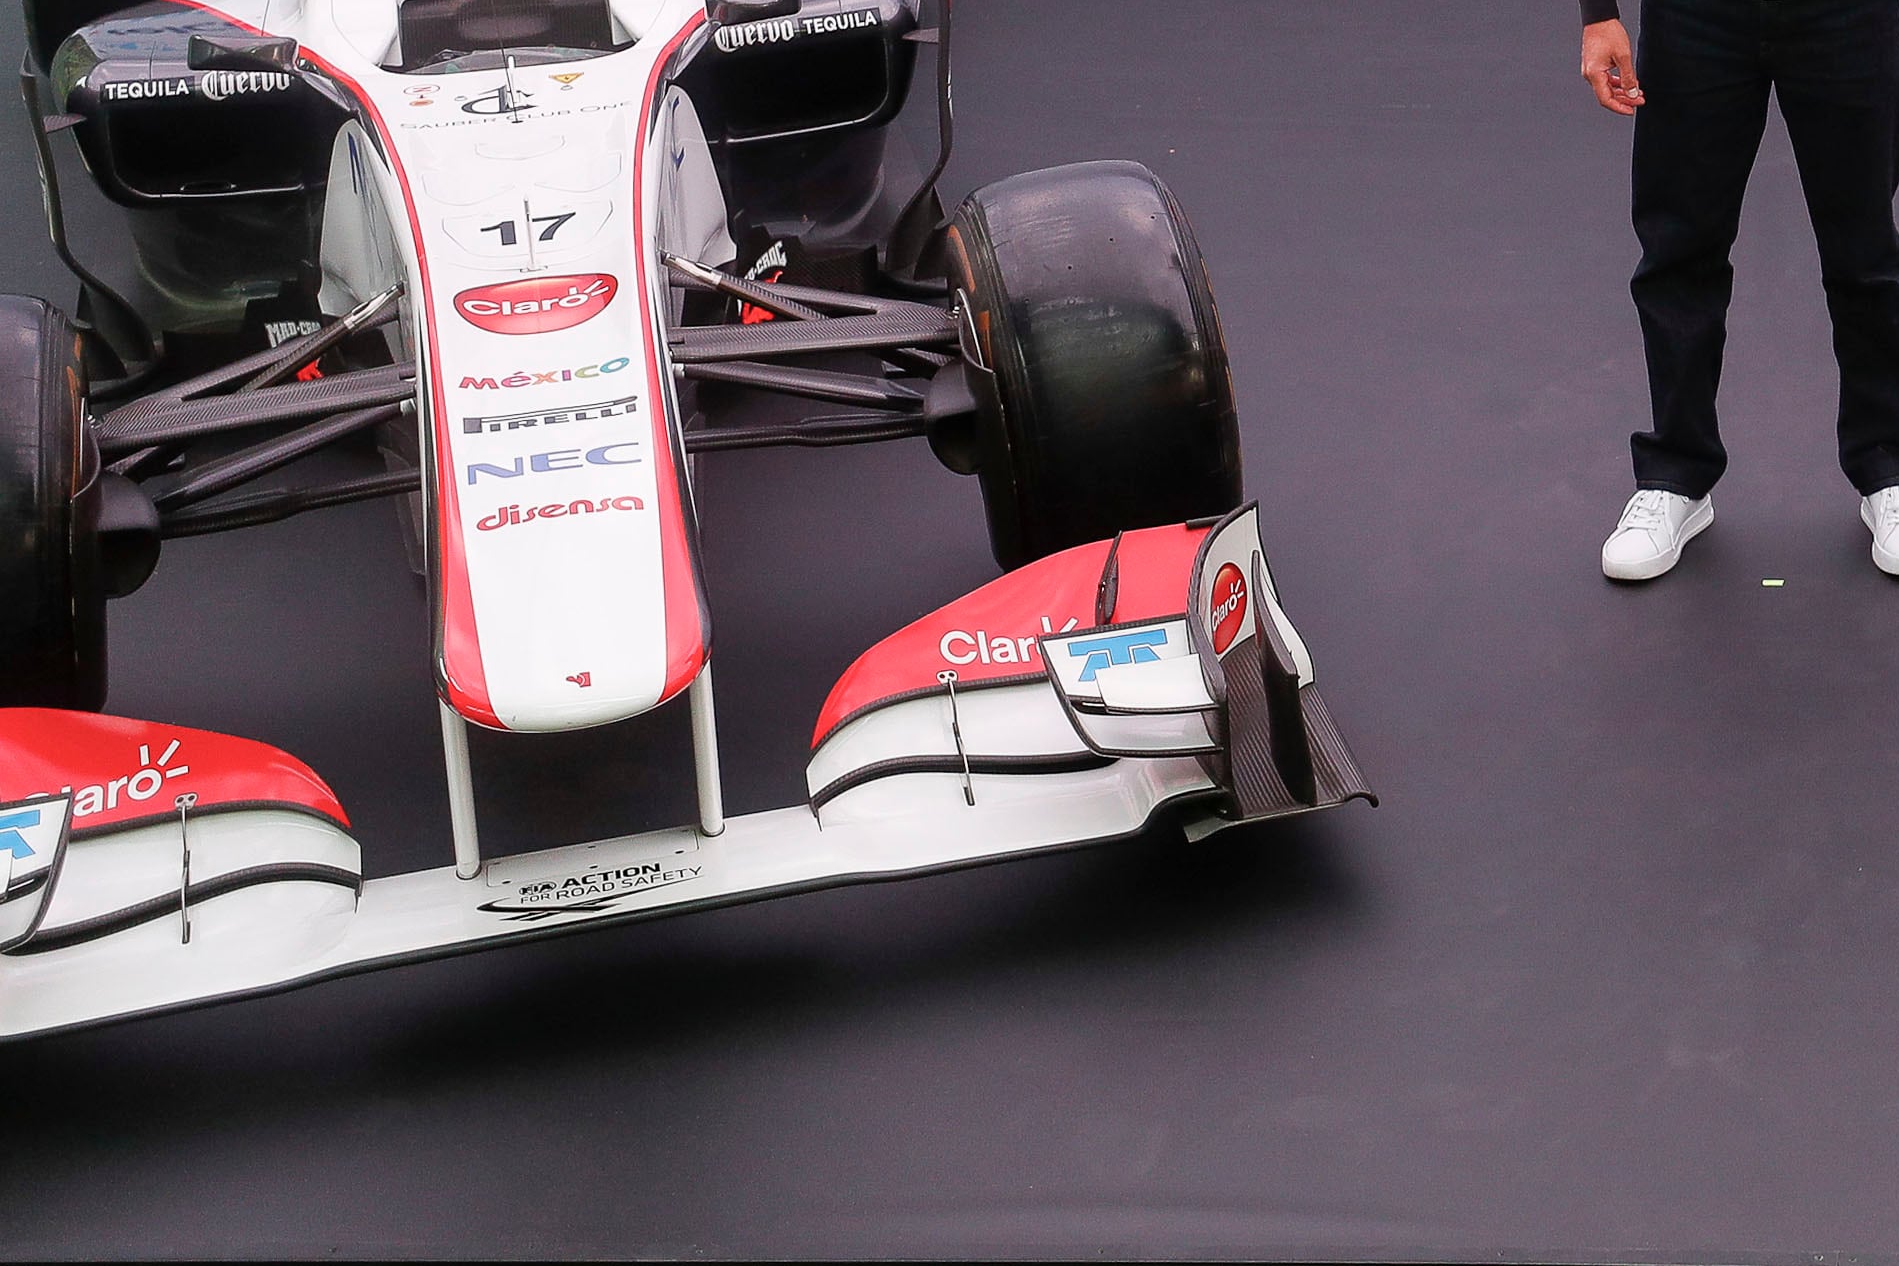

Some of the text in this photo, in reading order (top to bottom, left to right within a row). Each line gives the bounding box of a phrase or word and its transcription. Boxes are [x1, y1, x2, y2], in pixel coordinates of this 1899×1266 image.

[714, 9, 880, 54] Cuervo TEQUILA
[104, 71, 295, 102] TEQUILA Cuervo
[479, 211, 577, 246] 17
[462, 291, 593, 316] Claro
[462, 395, 639, 434] PIRELLI
[466, 441, 643, 486] NEC
[475, 494, 646, 532] disensa
[1211, 591, 1240, 632] Claro
[938, 629, 1044, 666] Clar
[520, 865, 703, 905] FOR ROAD SAFETY
[561, 862, 661, 889] ACTION
